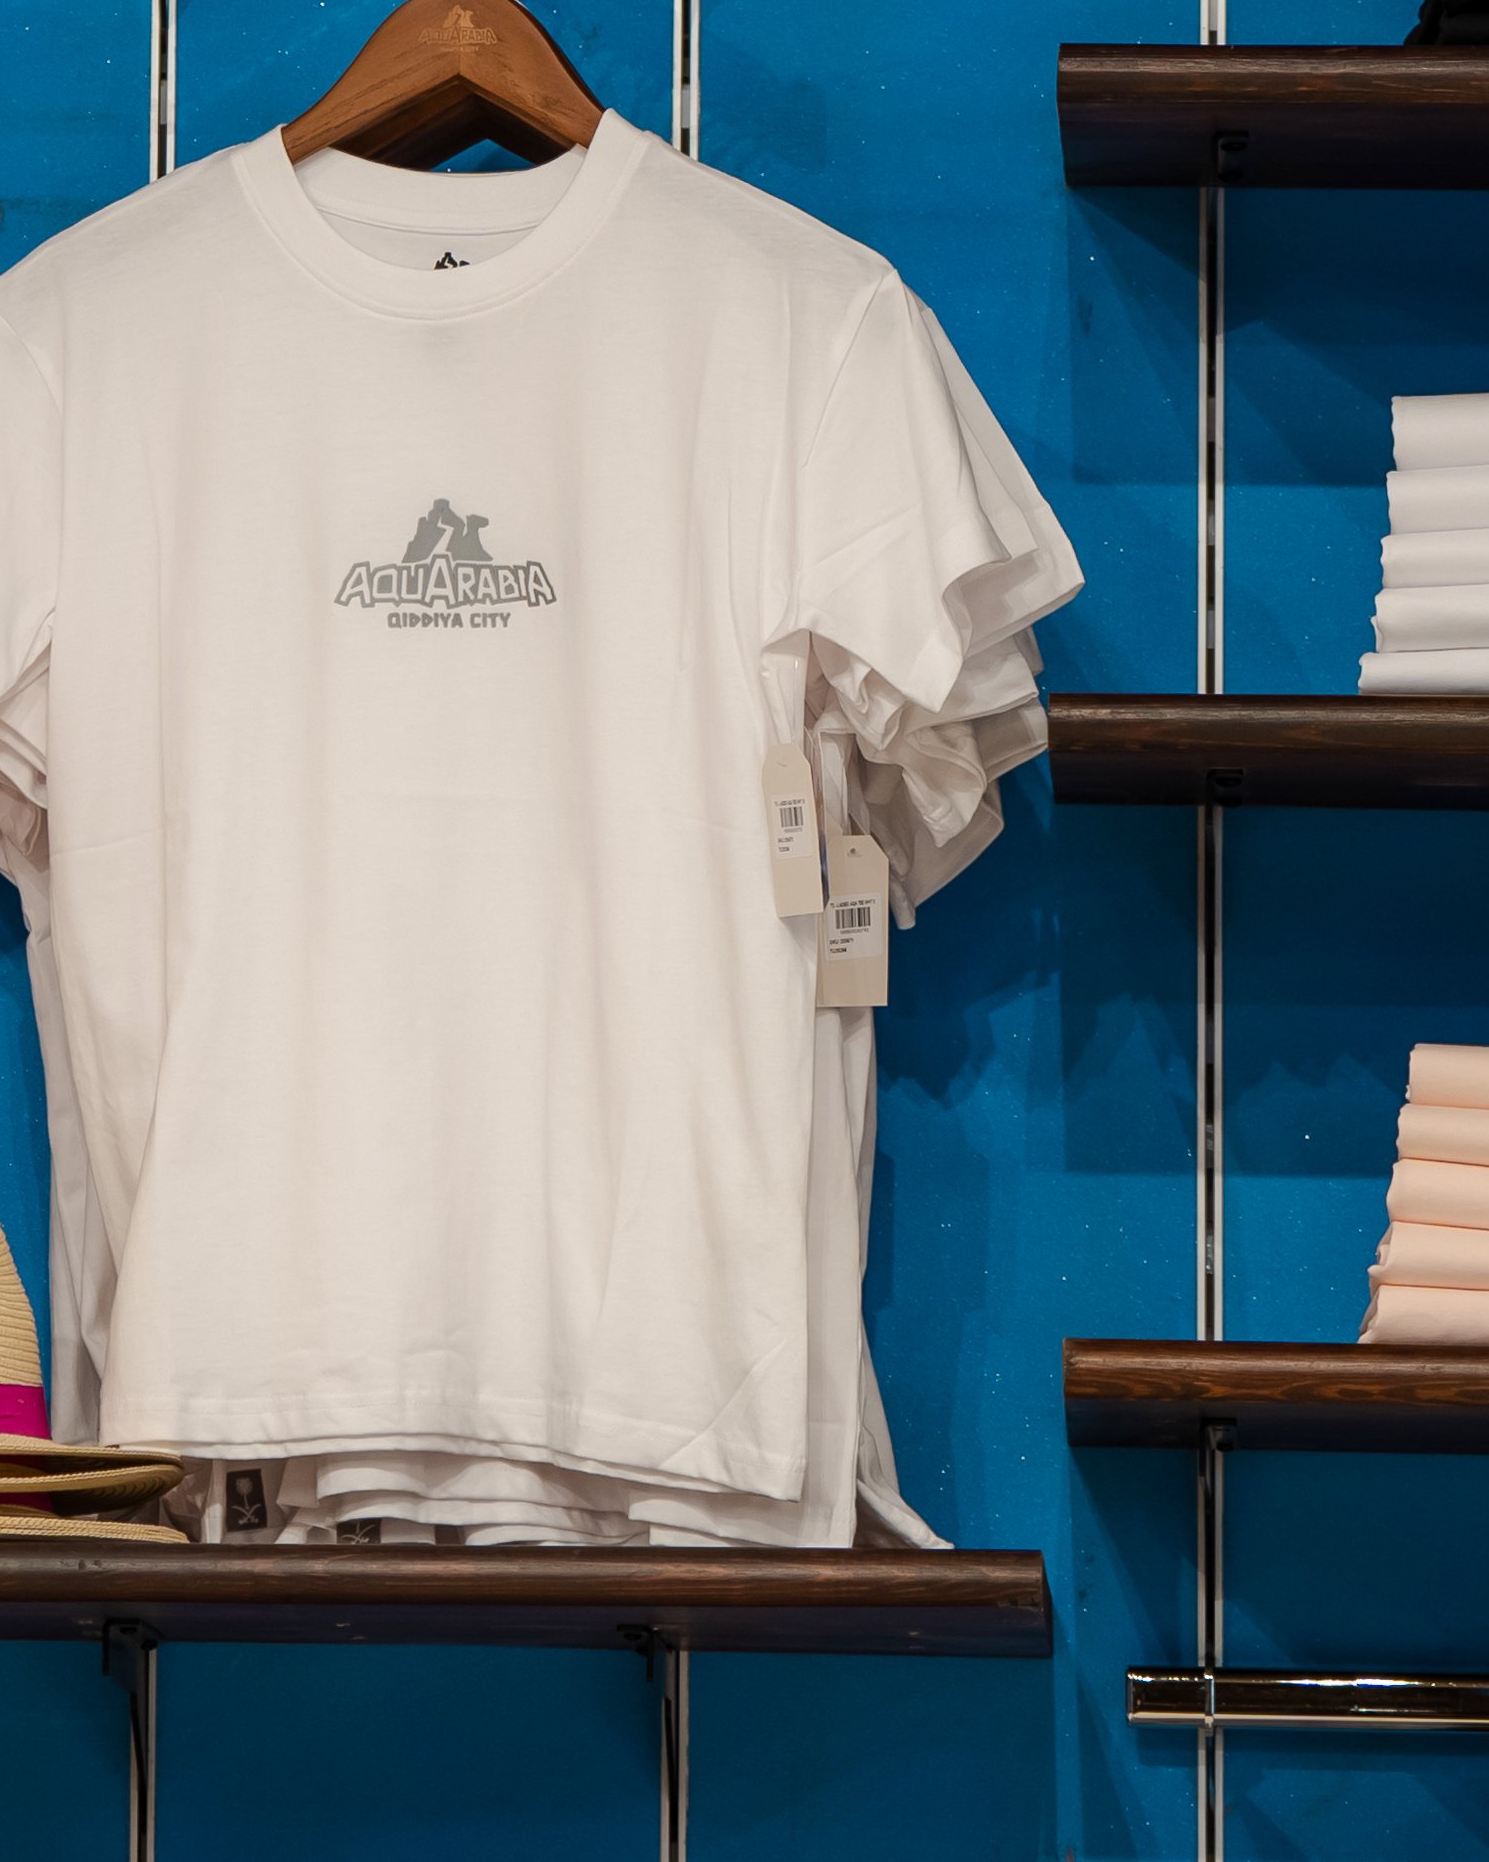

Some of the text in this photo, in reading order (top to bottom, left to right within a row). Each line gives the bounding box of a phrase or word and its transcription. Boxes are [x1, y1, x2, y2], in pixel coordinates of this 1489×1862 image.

[333, 554, 557, 609] AQUARABIA
[388, 612, 511, 628] QIDDIYA CITY
